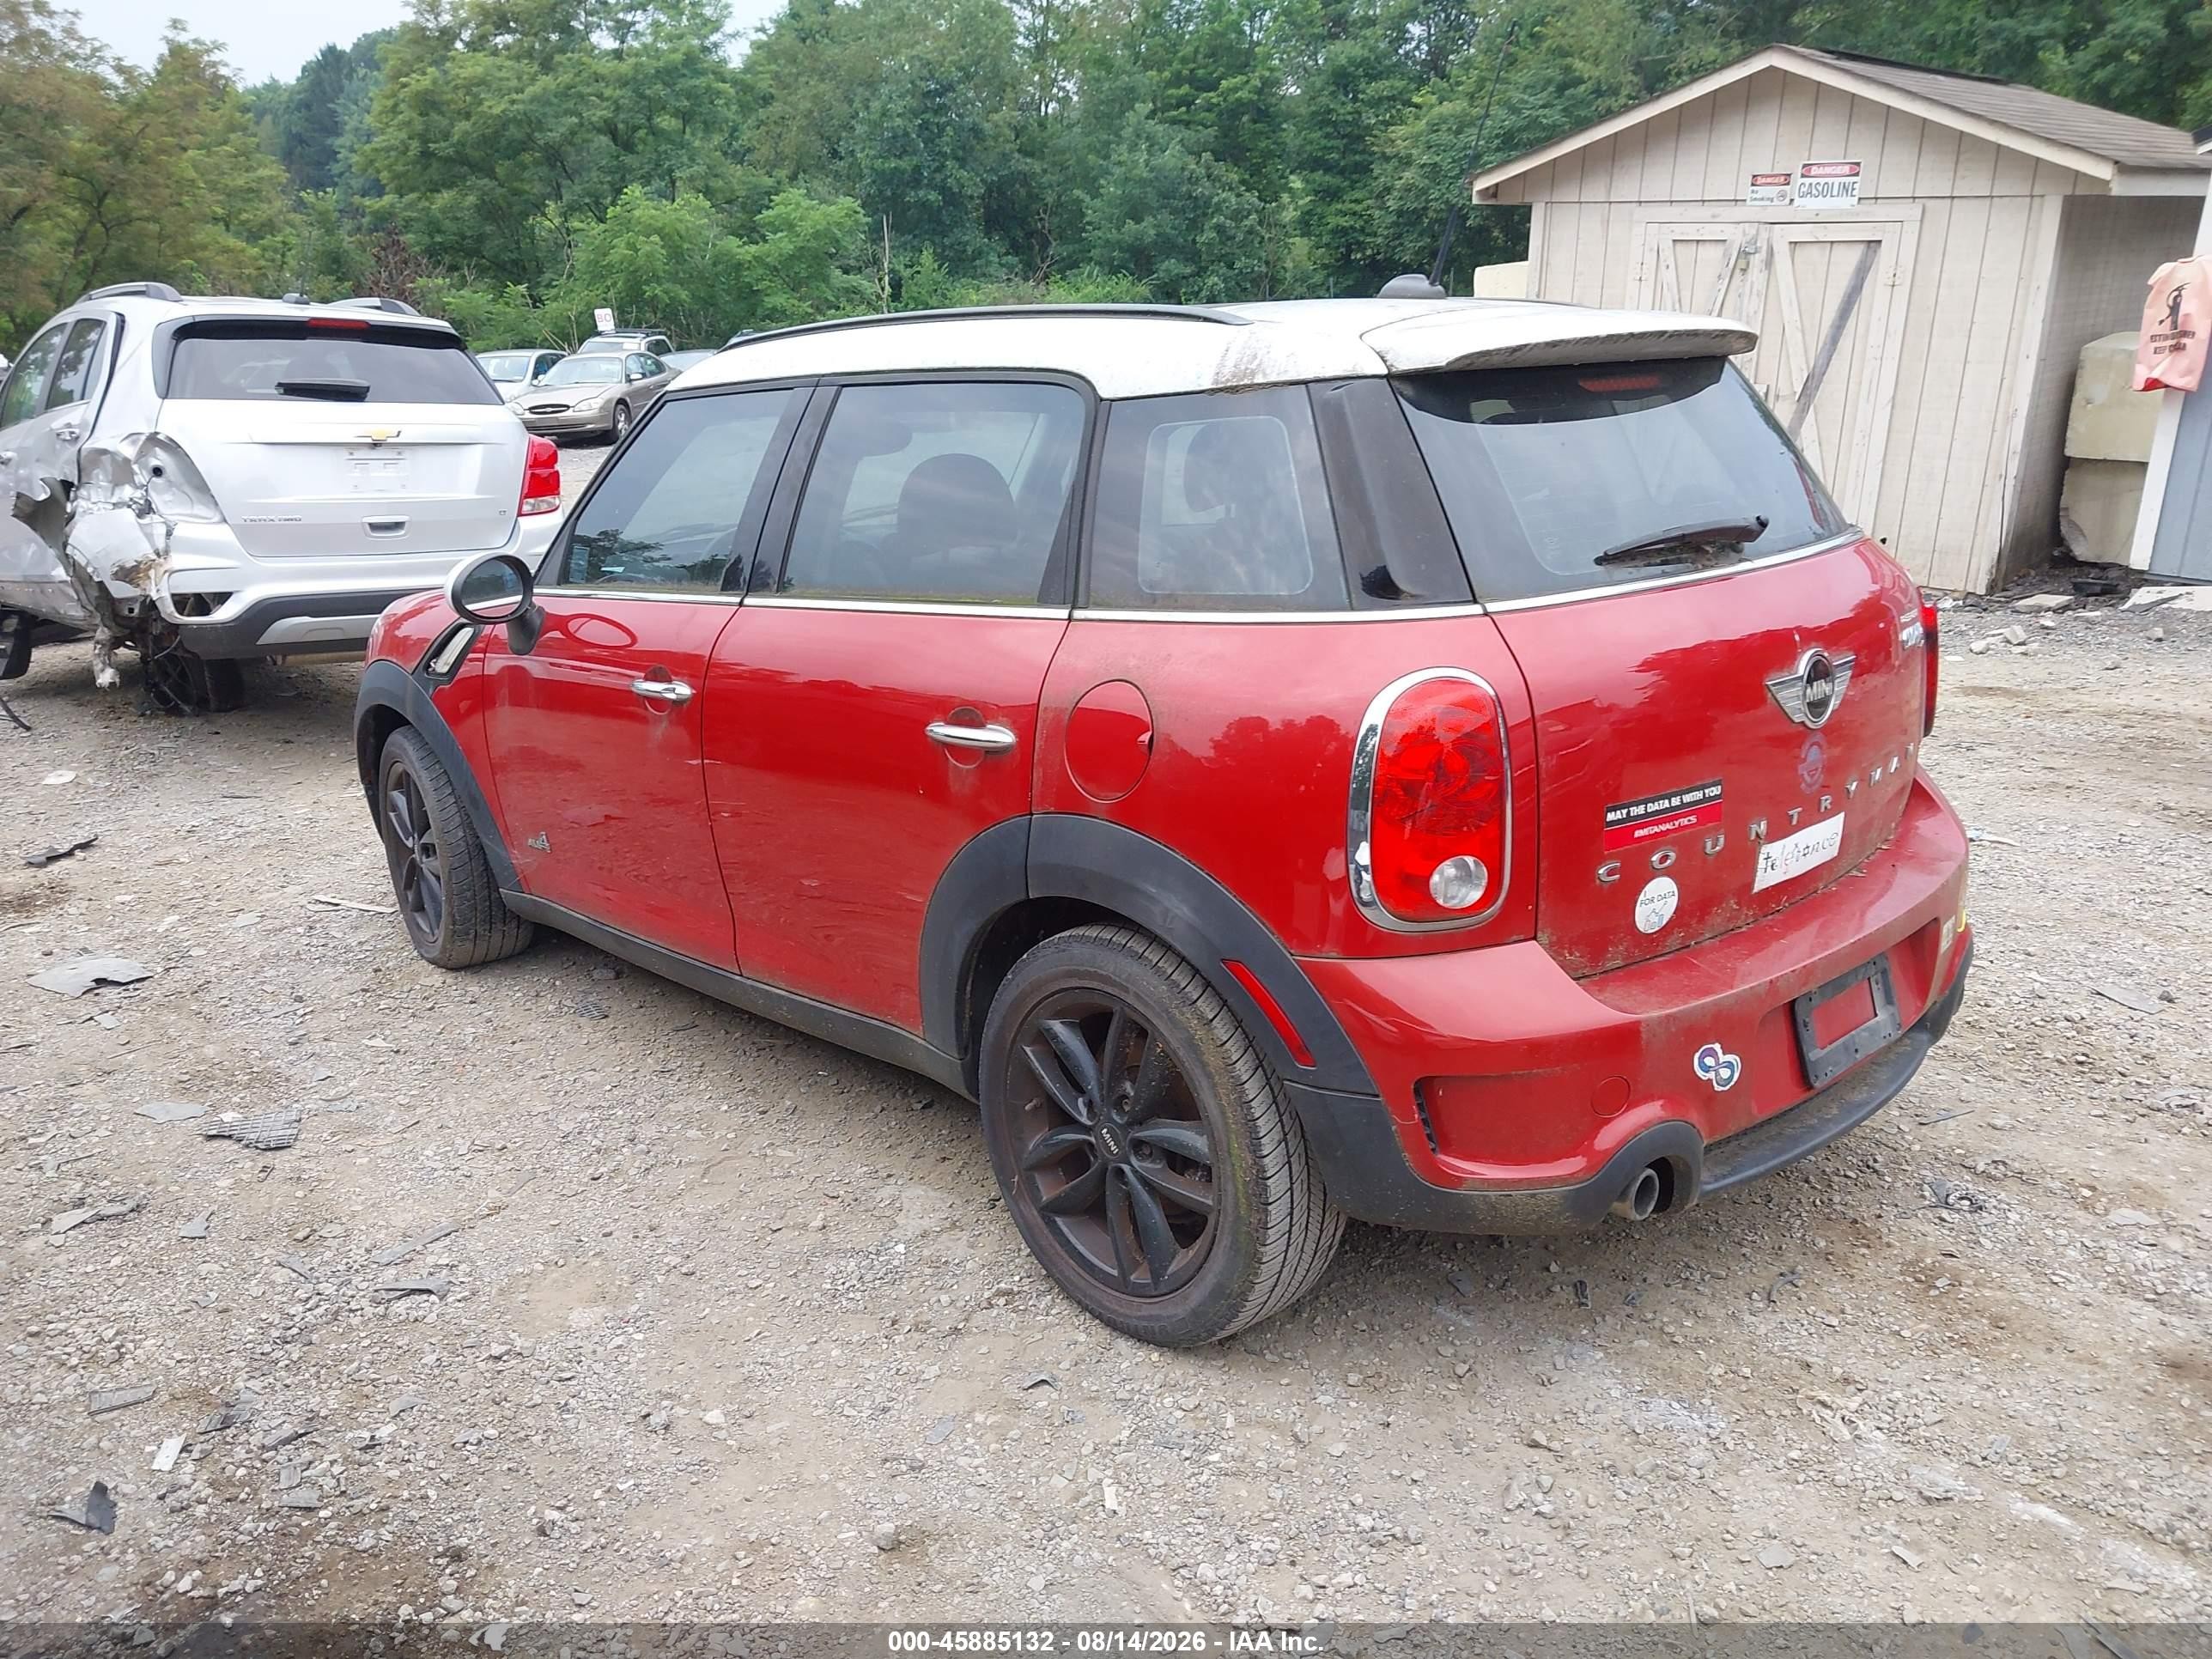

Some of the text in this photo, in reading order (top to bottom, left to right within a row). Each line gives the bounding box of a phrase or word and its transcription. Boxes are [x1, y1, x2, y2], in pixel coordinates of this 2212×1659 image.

[1811, 165, 1850, 175] DANGER
[1798, 181, 1858, 198] GASOLINE
[1806, 676, 1833, 702] MINI
[1606, 785, 1722, 822] MAY THE DATA BE WITH YOU
[1639, 890, 1675, 907] FOR DATA
[1101, 1127, 1119, 1154] MINI
